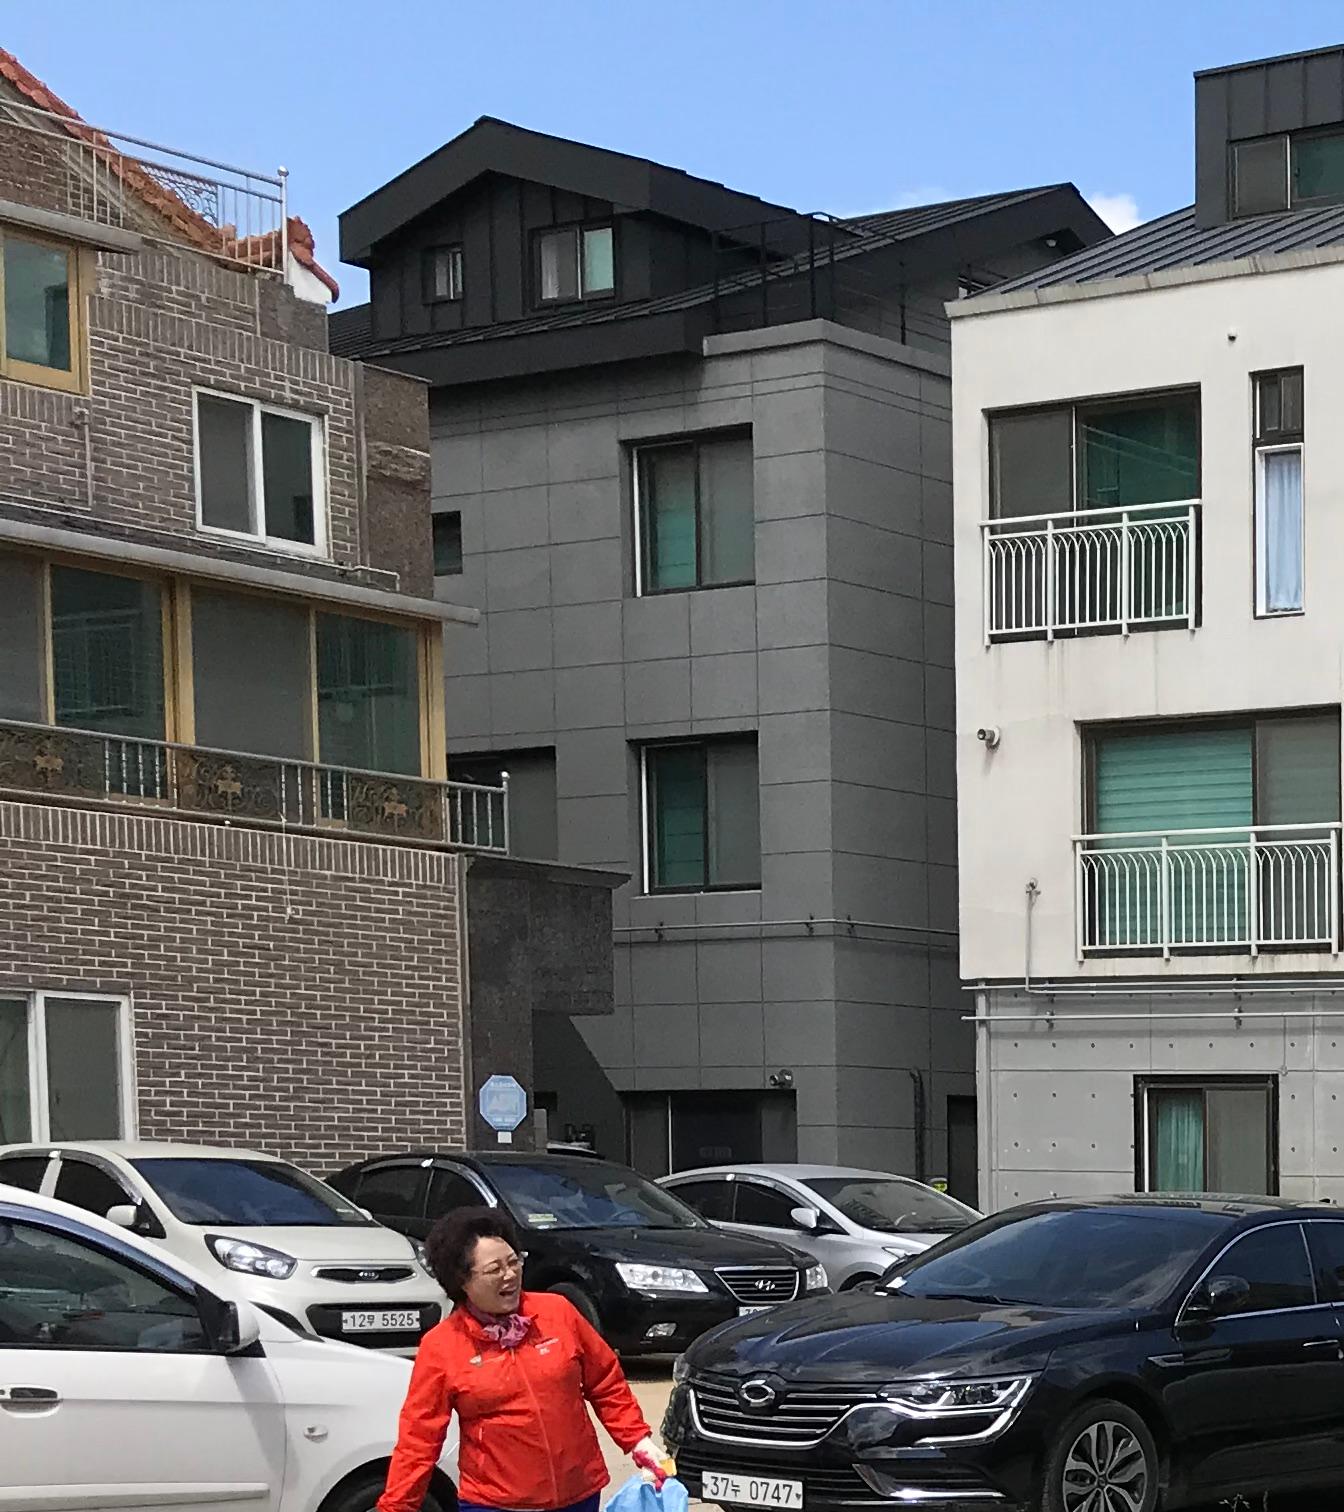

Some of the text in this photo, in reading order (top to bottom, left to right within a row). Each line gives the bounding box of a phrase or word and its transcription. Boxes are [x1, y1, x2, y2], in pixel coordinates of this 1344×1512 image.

[382, 1312, 414, 1327] 5525
[711, 1476, 793, 1504] 37누 0747
